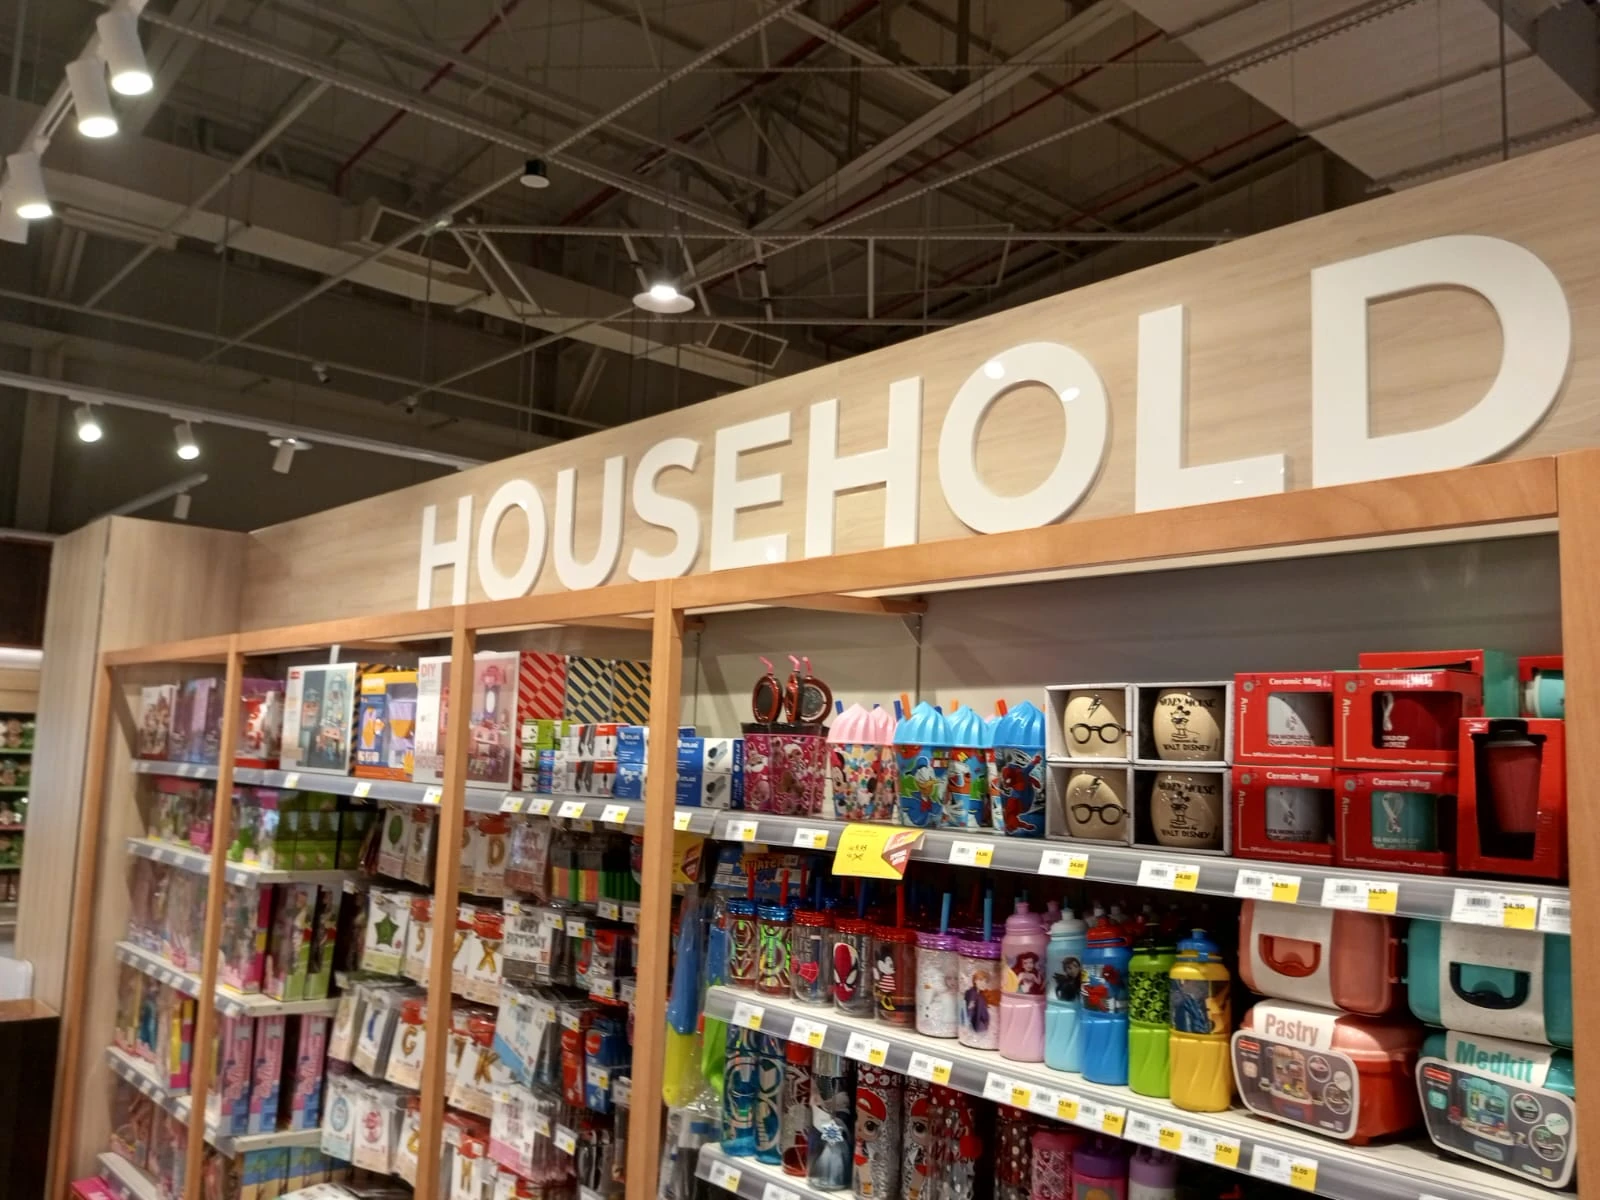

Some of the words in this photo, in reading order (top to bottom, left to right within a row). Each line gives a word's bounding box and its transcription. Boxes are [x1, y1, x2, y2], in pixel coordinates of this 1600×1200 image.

[415, 233, 1572, 612] HOUSEHOLD
[1268, 678, 1302, 686] Ceramic
[1303, 677, 1322, 687] Mug
[1162, 743, 1181, 752] WALT
[1183, 744, 1212, 753] DISNEY
[1266, 772, 1301, 781] Ceramic
[1301, 773, 1320, 784] Mug
[1372, 778, 1409, 787] Ceramic
[1410, 778, 1431, 790] Mug
[1160, 829, 1180, 838] WALT
[1182, 830, 1211, 840] DISNEY
[1264, 1013, 1320, 1047] Pastry
[1455, 1039, 1535, 1084] Medkit
